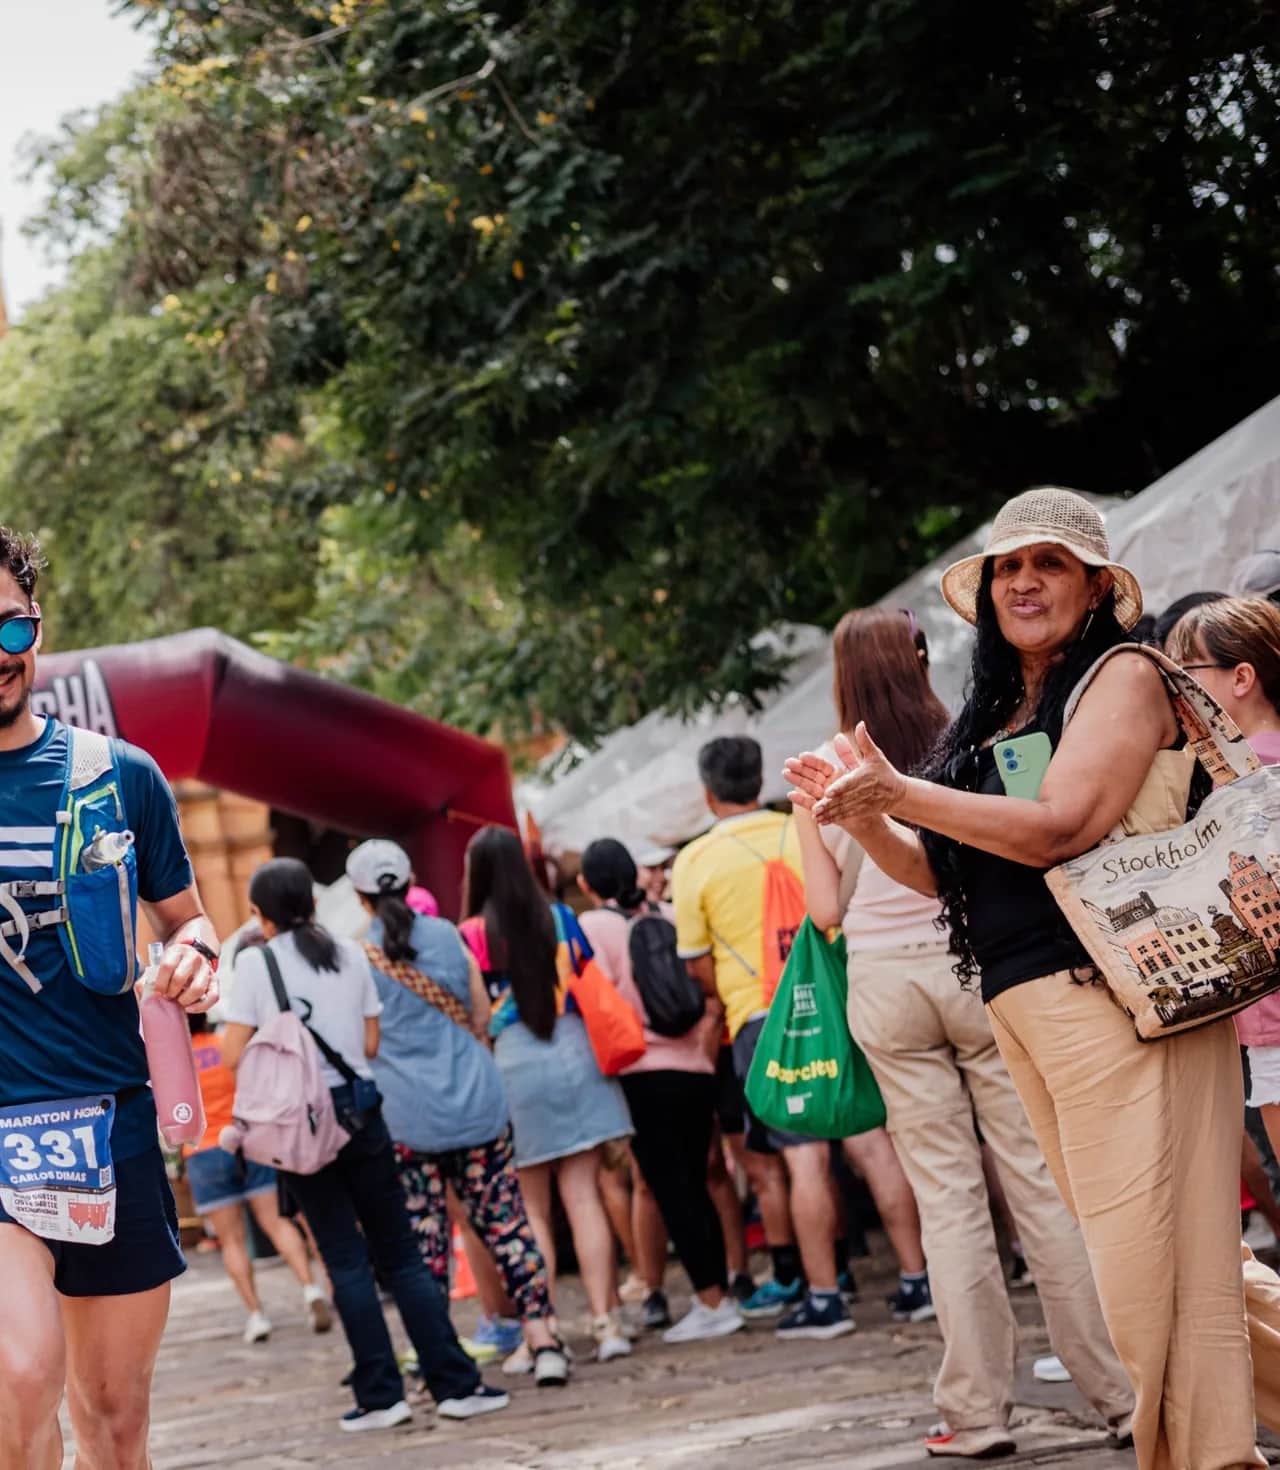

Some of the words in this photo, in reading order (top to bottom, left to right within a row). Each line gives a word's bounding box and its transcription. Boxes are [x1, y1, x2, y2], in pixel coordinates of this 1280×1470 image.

[1102, 818, 1222, 884] Stockholm
[0, 1110, 71, 1129] MARATON
[73, 1106, 106, 1120] HOKA
[3, 1125, 99, 1171] 331
[10, 1171, 55, 1184] CARLOS
[55, 1171, 87, 1183] DIMAS
